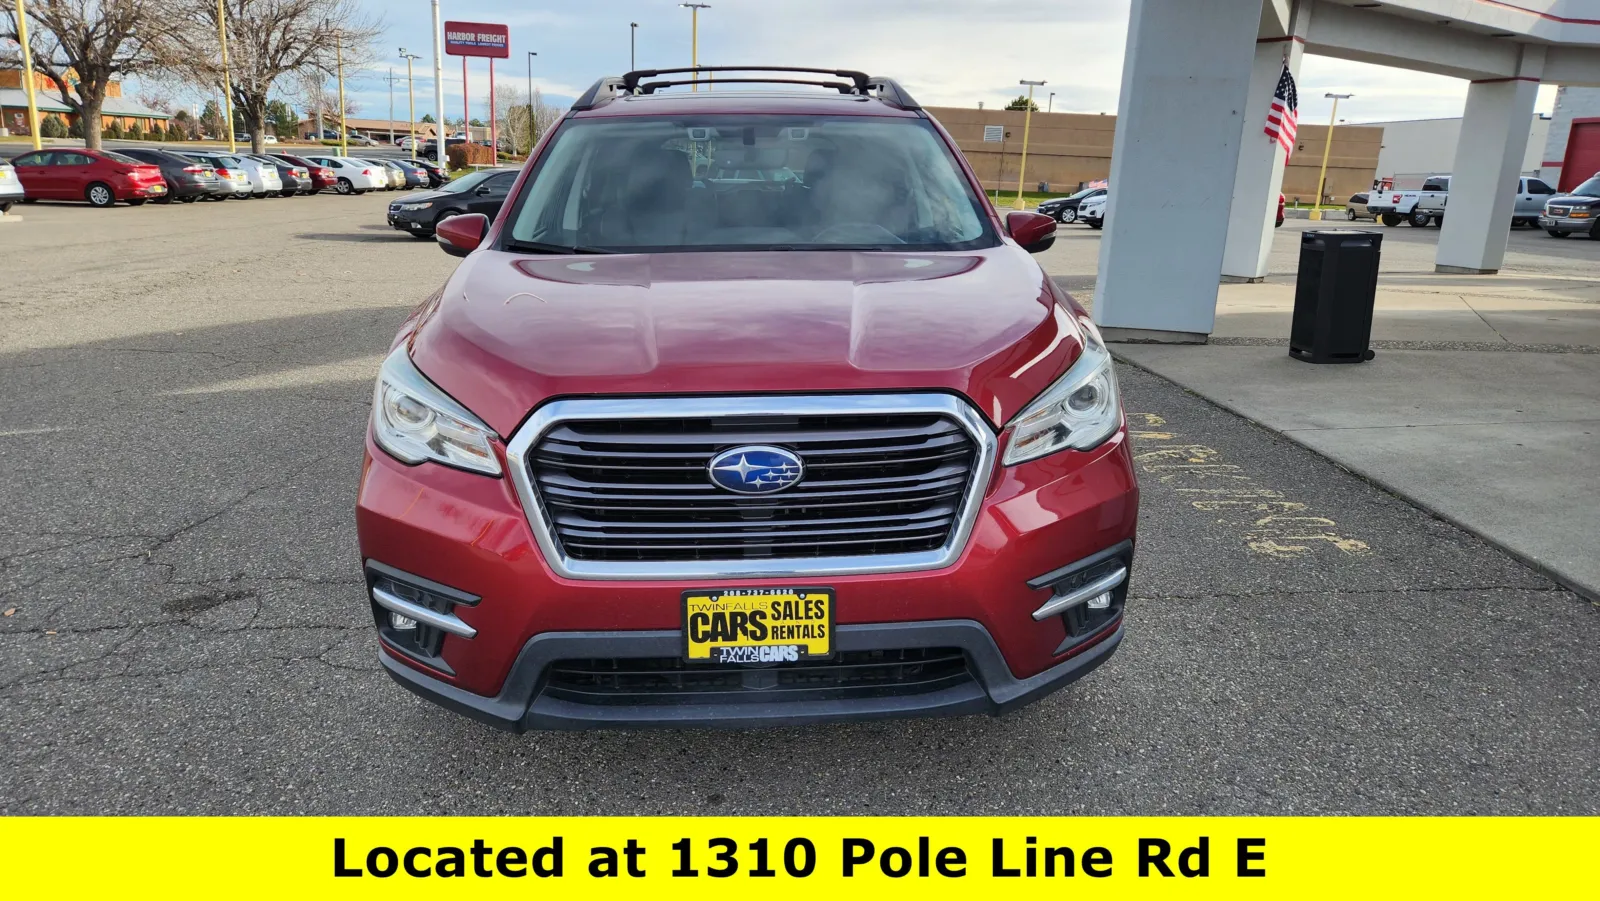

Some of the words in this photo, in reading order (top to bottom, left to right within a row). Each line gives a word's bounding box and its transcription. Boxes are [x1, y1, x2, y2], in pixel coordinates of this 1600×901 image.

[447, 31, 476, 41] HARBOR
[477, 33, 506, 43] FREIGHT
[771, 600, 825, 621] SALES
[689, 610, 768, 643] CARS
[771, 624, 826, 640] RENTALS
[720, 646, 759, 656] TWIN
[720, 655, 760, 663] FALLS
[759, 645, 799, 662] CARS
